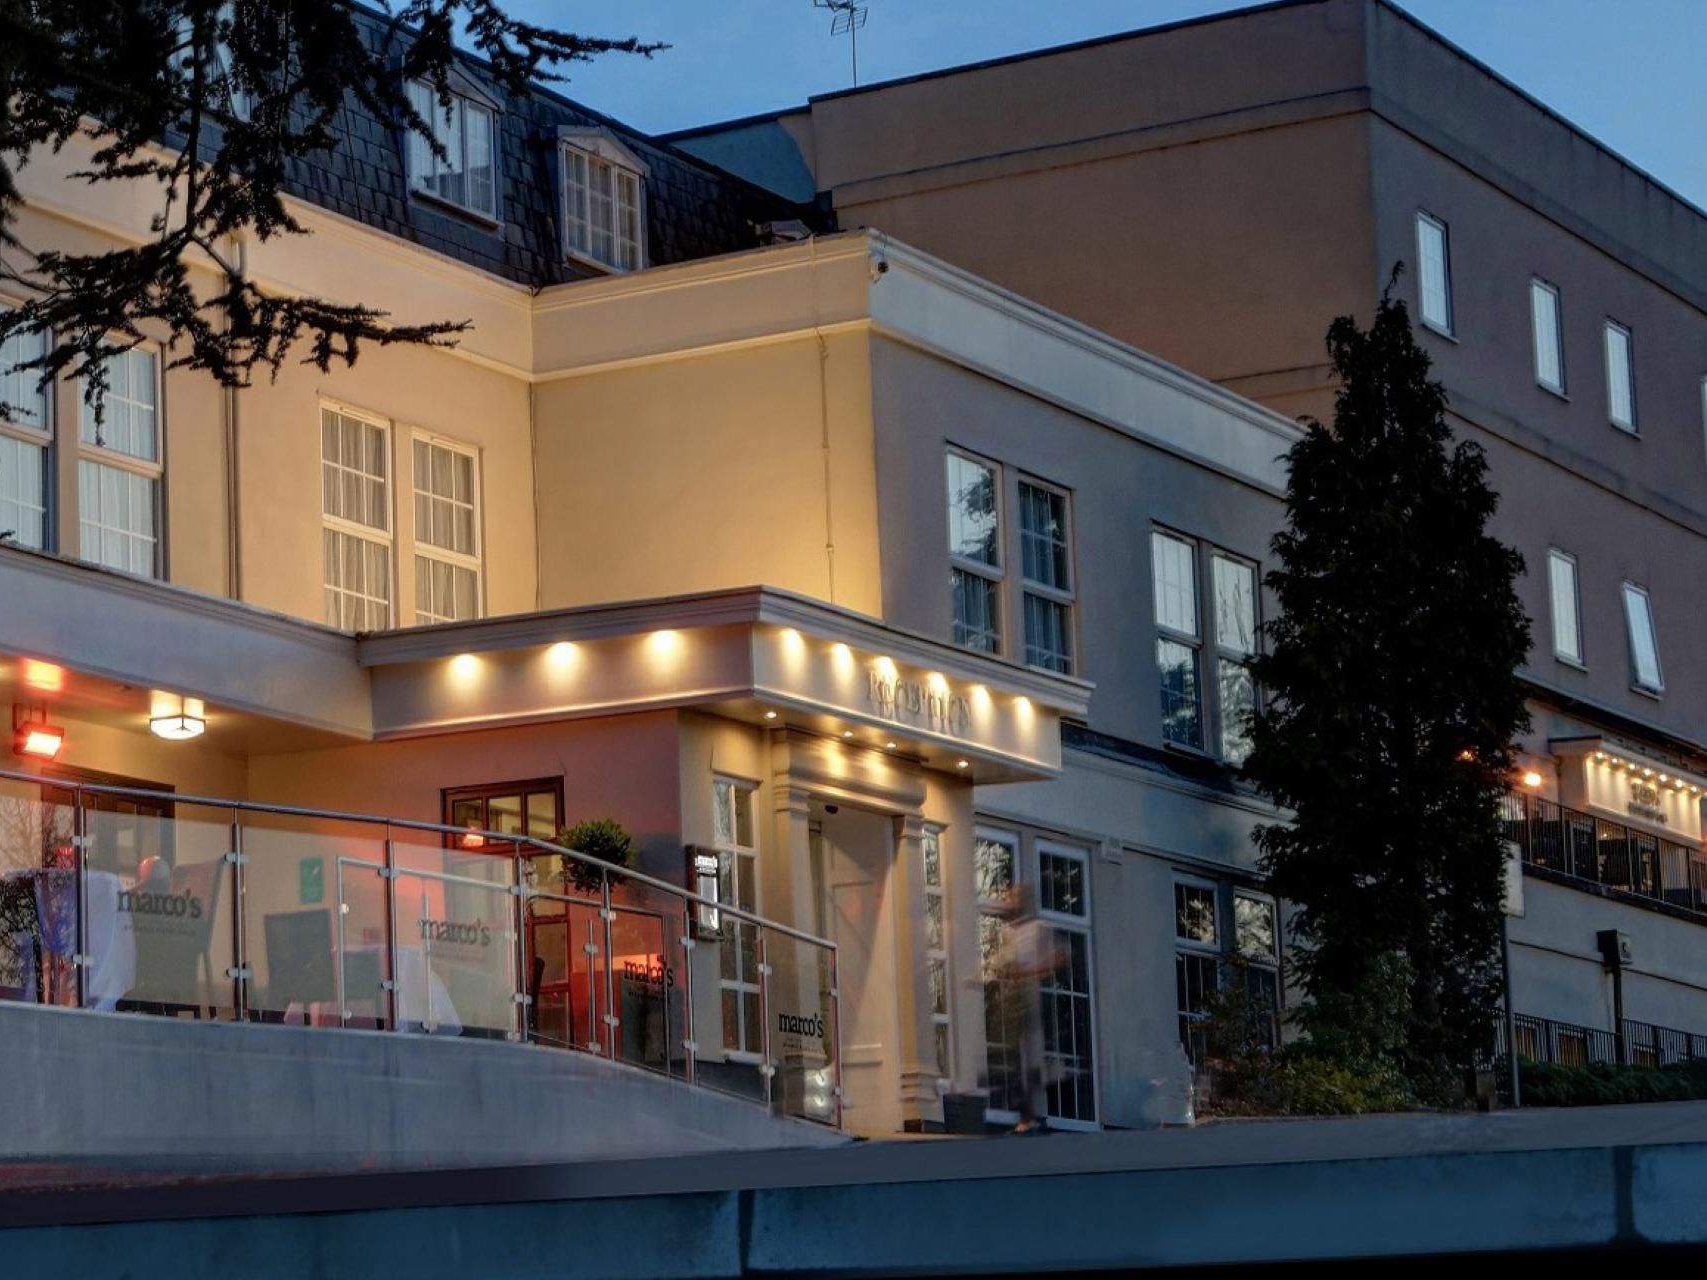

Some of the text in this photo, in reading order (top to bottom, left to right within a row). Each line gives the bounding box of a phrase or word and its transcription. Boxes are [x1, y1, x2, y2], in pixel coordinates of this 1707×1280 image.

[117, 888, 202, 919] marco's
[418, 917, 491, 947] marco's
[624, 959, 674, 987] marco's
[778, 1012, 824, 1039] marco's
